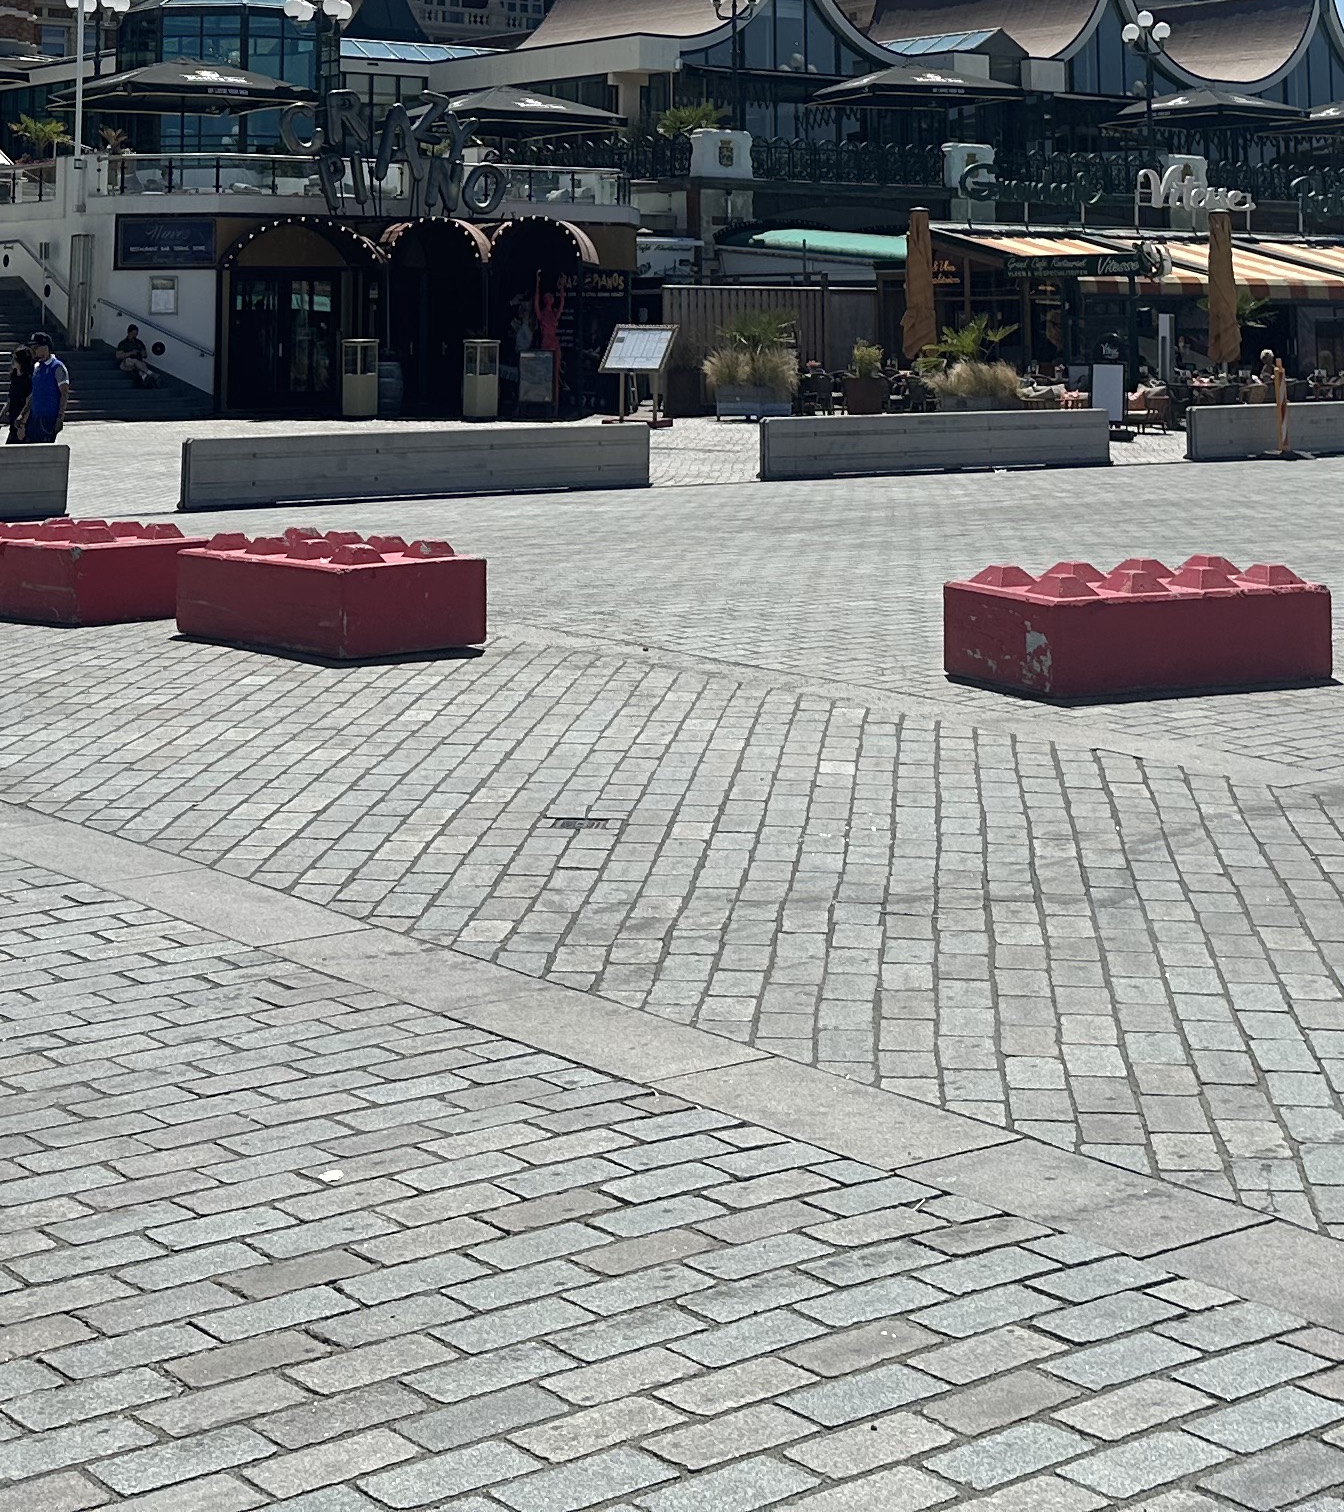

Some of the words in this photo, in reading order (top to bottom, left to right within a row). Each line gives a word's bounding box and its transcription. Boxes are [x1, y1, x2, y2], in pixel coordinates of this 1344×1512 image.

[279, 89, 480, 181] CRAZY
[1136, 164, 1256, 211] Vitesse
[1096, 255, 1140, 276] Vitesse
